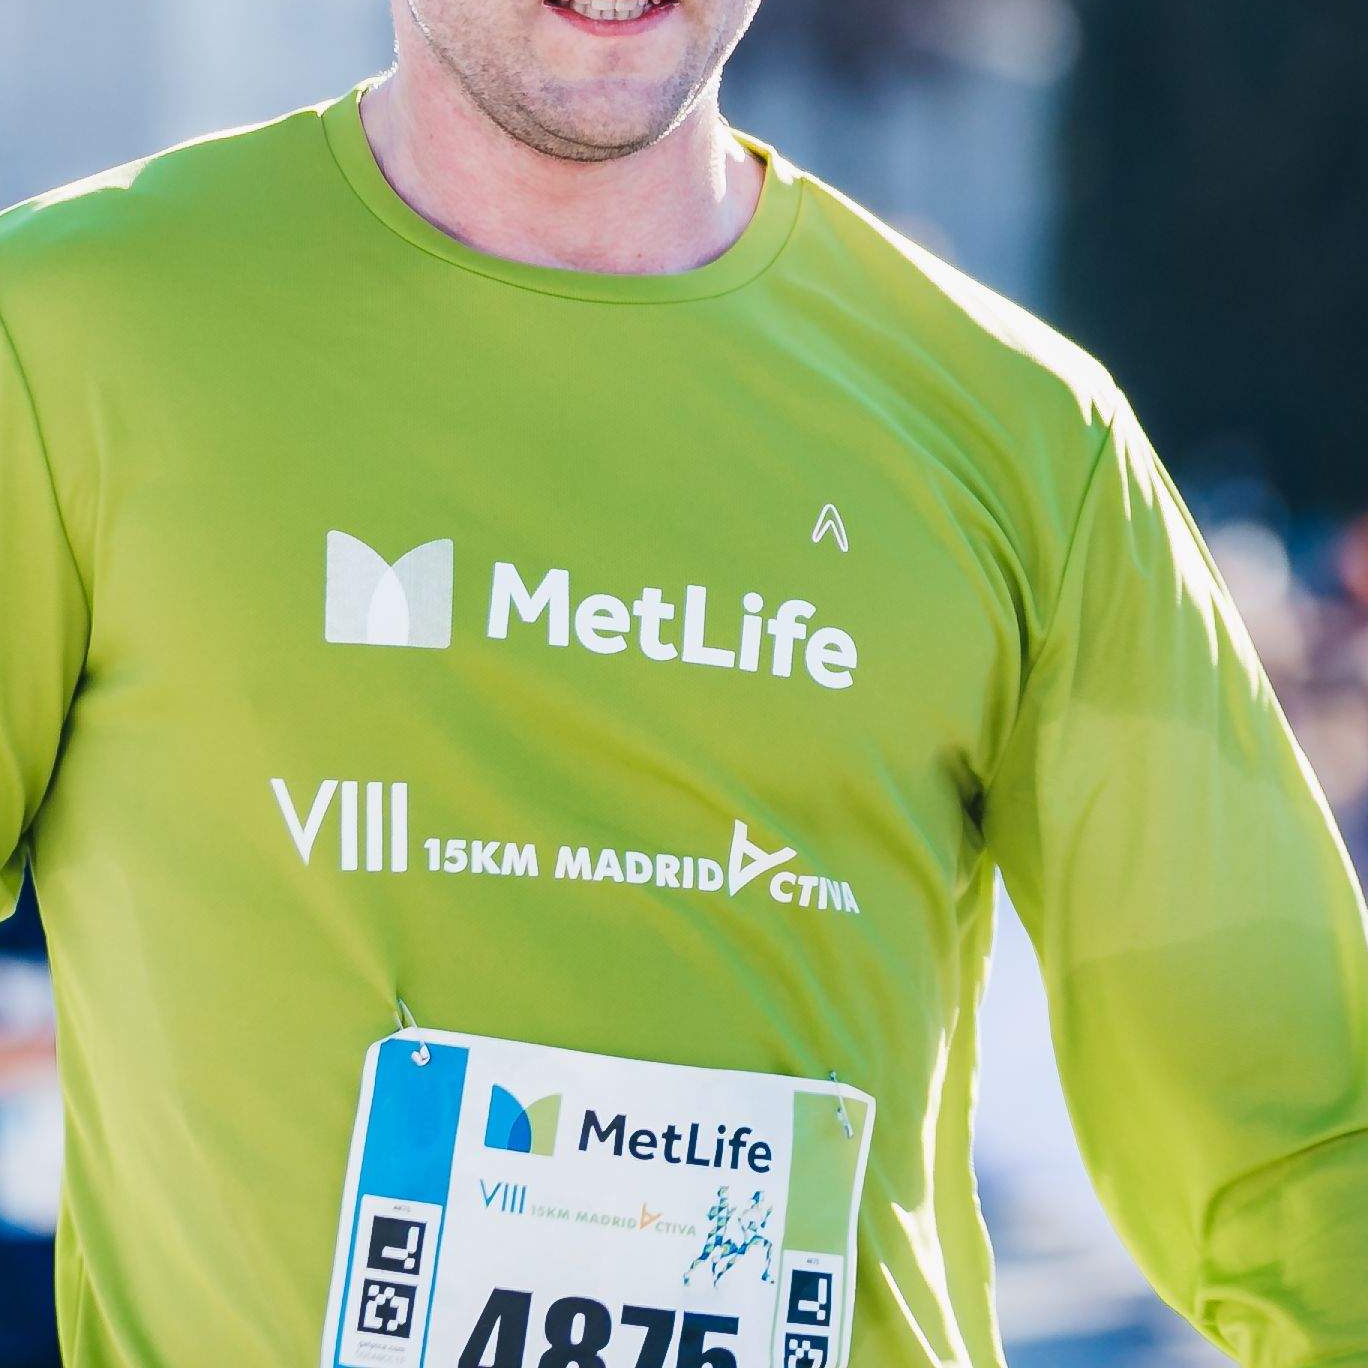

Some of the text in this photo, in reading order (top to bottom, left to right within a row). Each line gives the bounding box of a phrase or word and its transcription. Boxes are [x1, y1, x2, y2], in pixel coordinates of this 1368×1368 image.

[486, 560, 858, 690] MetLife
[269, 778, 408, 873] VIII
[423, 837, 539, 877] 15KM
[554, 845, 725, 892] MADRID
[578, 1108, 773, 1174] MetLife
[479, 1178, 527, 1215] VIII
[531, 1203, 571, 1220] 15KM
[574, 1210, 637, 1230] MADRID
[456, 1286, 740, 1368] 4875
